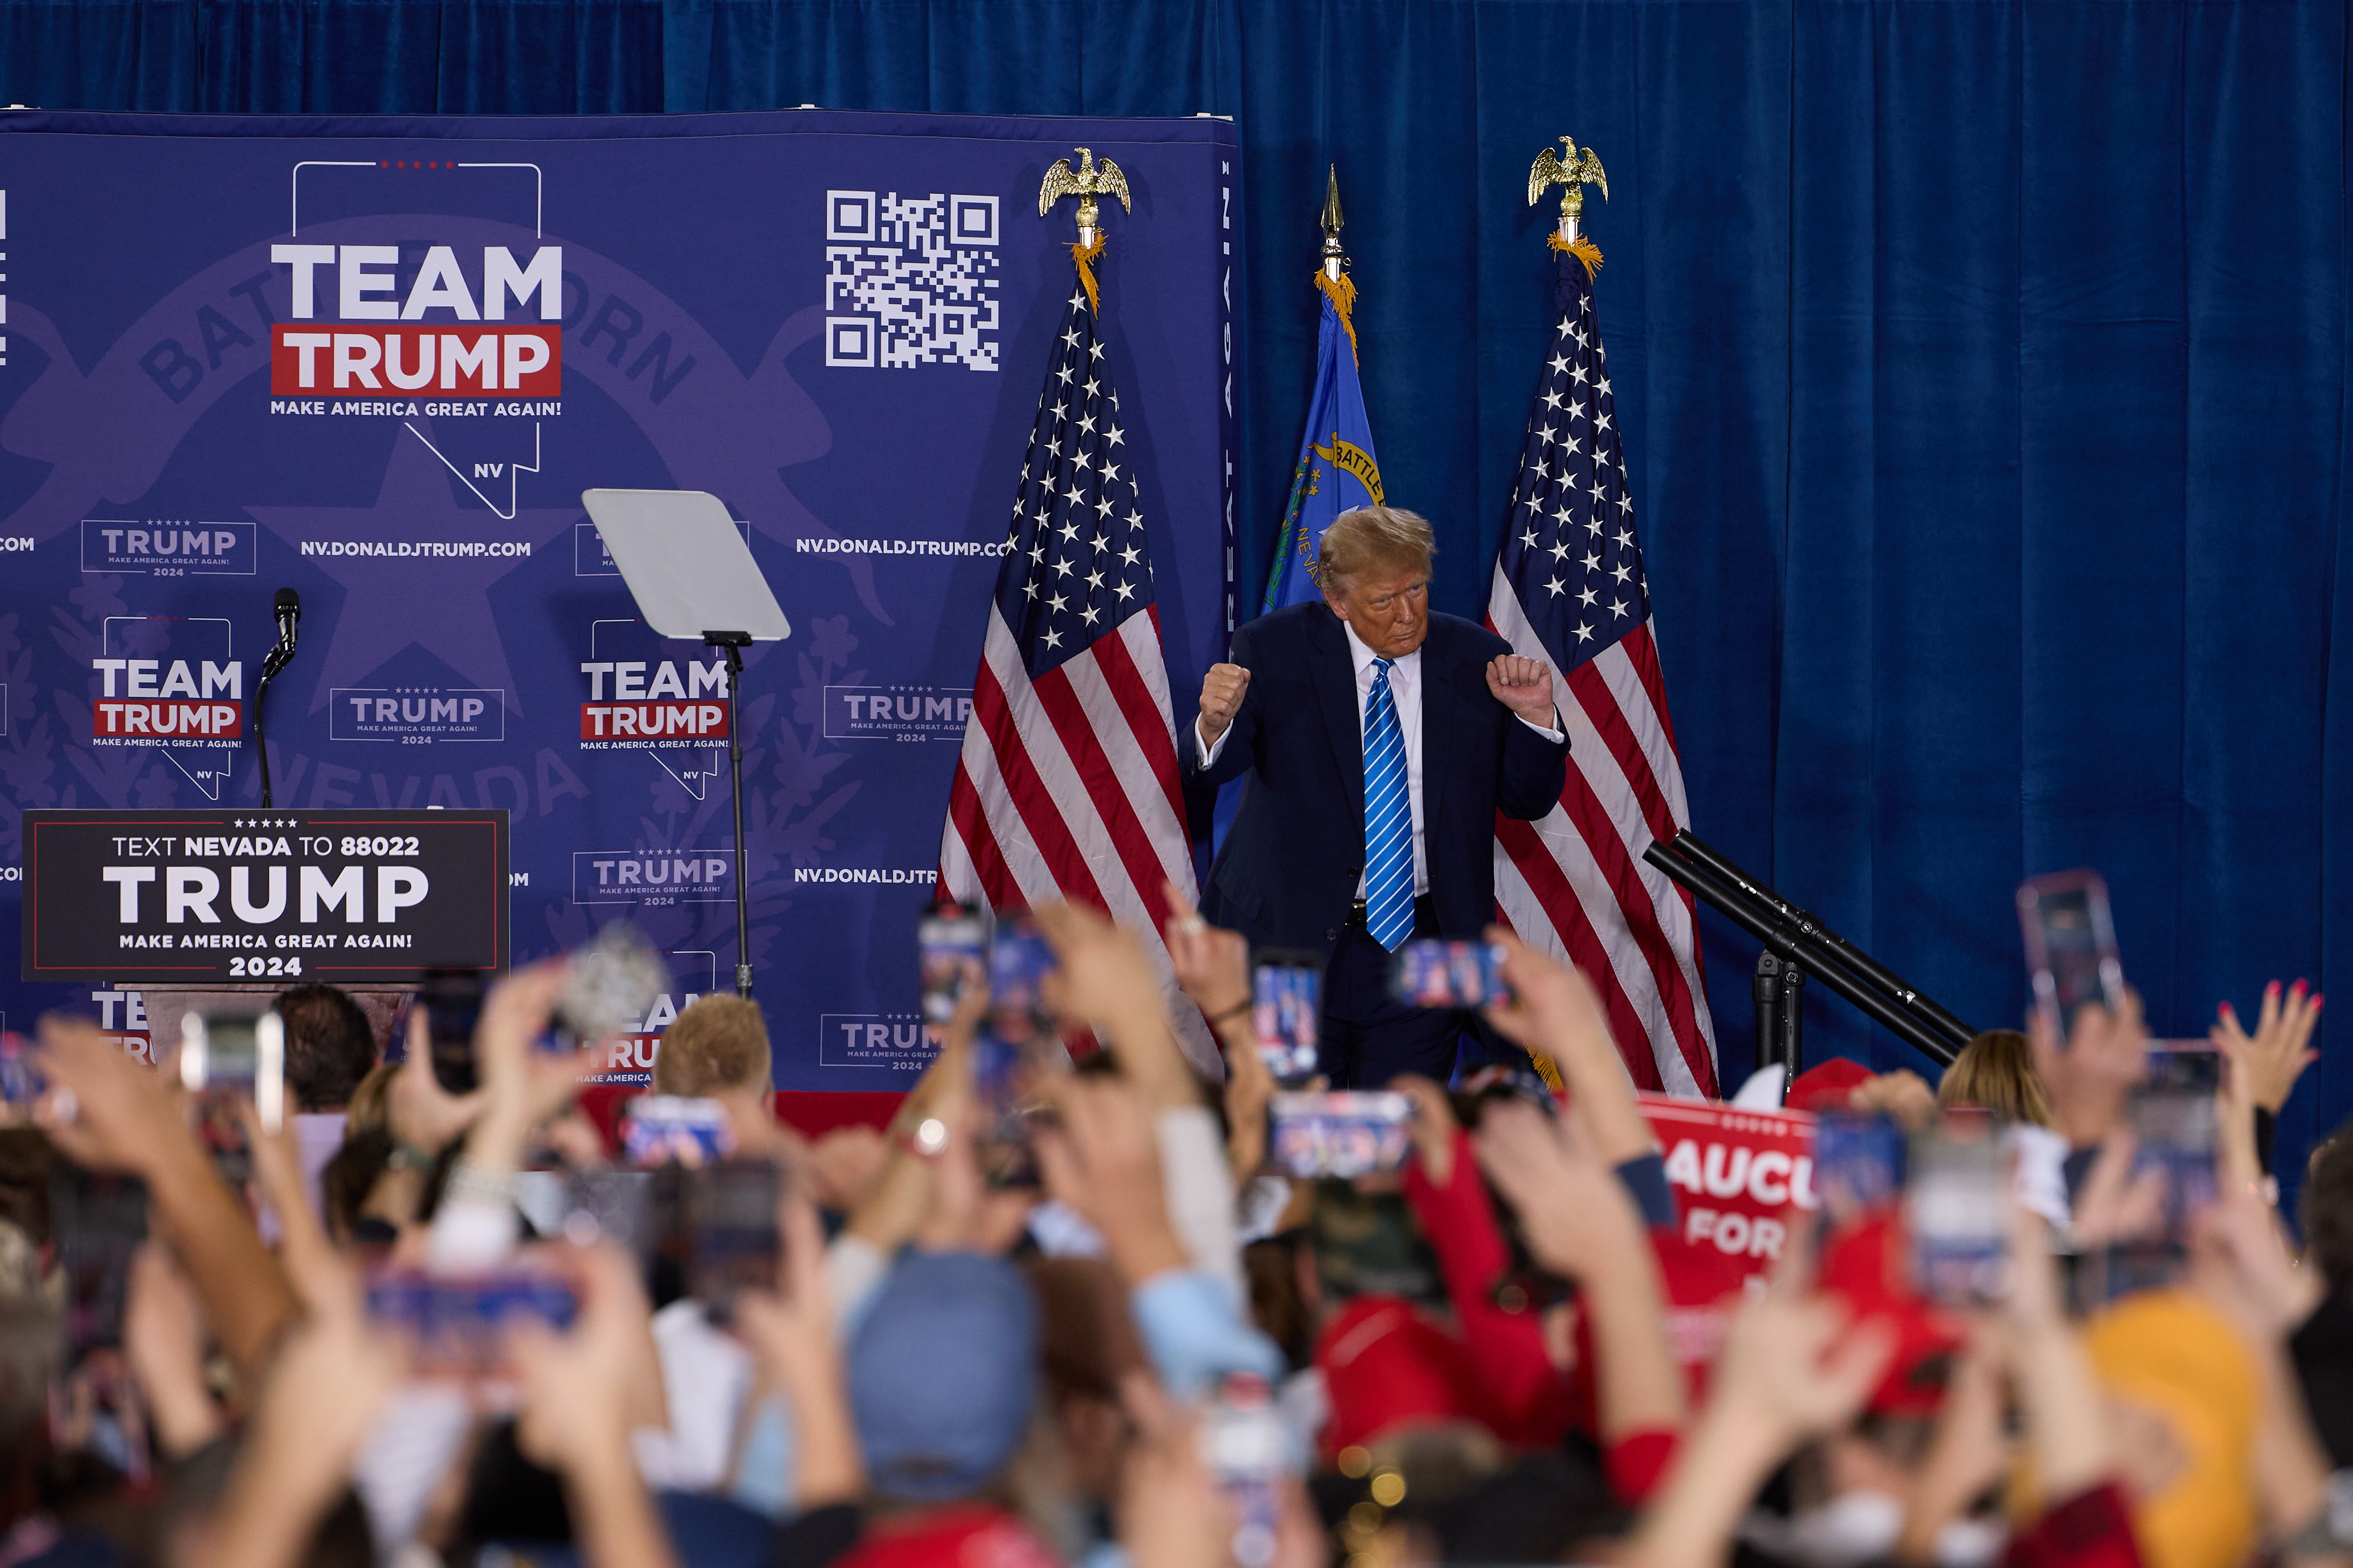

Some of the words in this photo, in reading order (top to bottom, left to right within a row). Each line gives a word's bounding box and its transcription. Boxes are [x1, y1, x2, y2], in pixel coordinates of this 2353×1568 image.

[271, 244, 562, 320] TEAM
[284, 333, 549, 389] TRUMP
[271, 401, 324, 415] MAKE
[331, 402, 419, 416] AMERICA
[425, 403, 488, 416] GREAT
[494, 403, 561, 416] AGAIN!
[475, 464, 503, 477] NV
[102, 530, 235, 555] TRUMP
[301, 542, 530, 556] NV.DONALDJTRUMP.COM
[93, 660, 242, 699] TEAM
[581, 661, 730, 700] TEAM
[100, 704, 235, 734] TRUMP
[350, 698, 484, 722] TRUMP
[587, 706, 722, 735] TRUMP
[112, 838, 176, 855] TEXT
[185, 837, 292, 855] NEVADA
[299, 837, 332, 855] TO
[341, 837, 419, 855] 88022
[593, 859, 726, 885] TRUMP
[103, 866, 428, 923] TRUMP
[120, 935, 173, 948] MAKE
[180, 935, 267, 948] AMERICA
[275, 935, 337, 948] GREAT
[344, 935, 411, 948] AGAIN!
[230, 957, 301, 976] 2024
[605, 1072, 651, 1082] AMERICA
[1686, 1207, 1786, 1260] FOR
